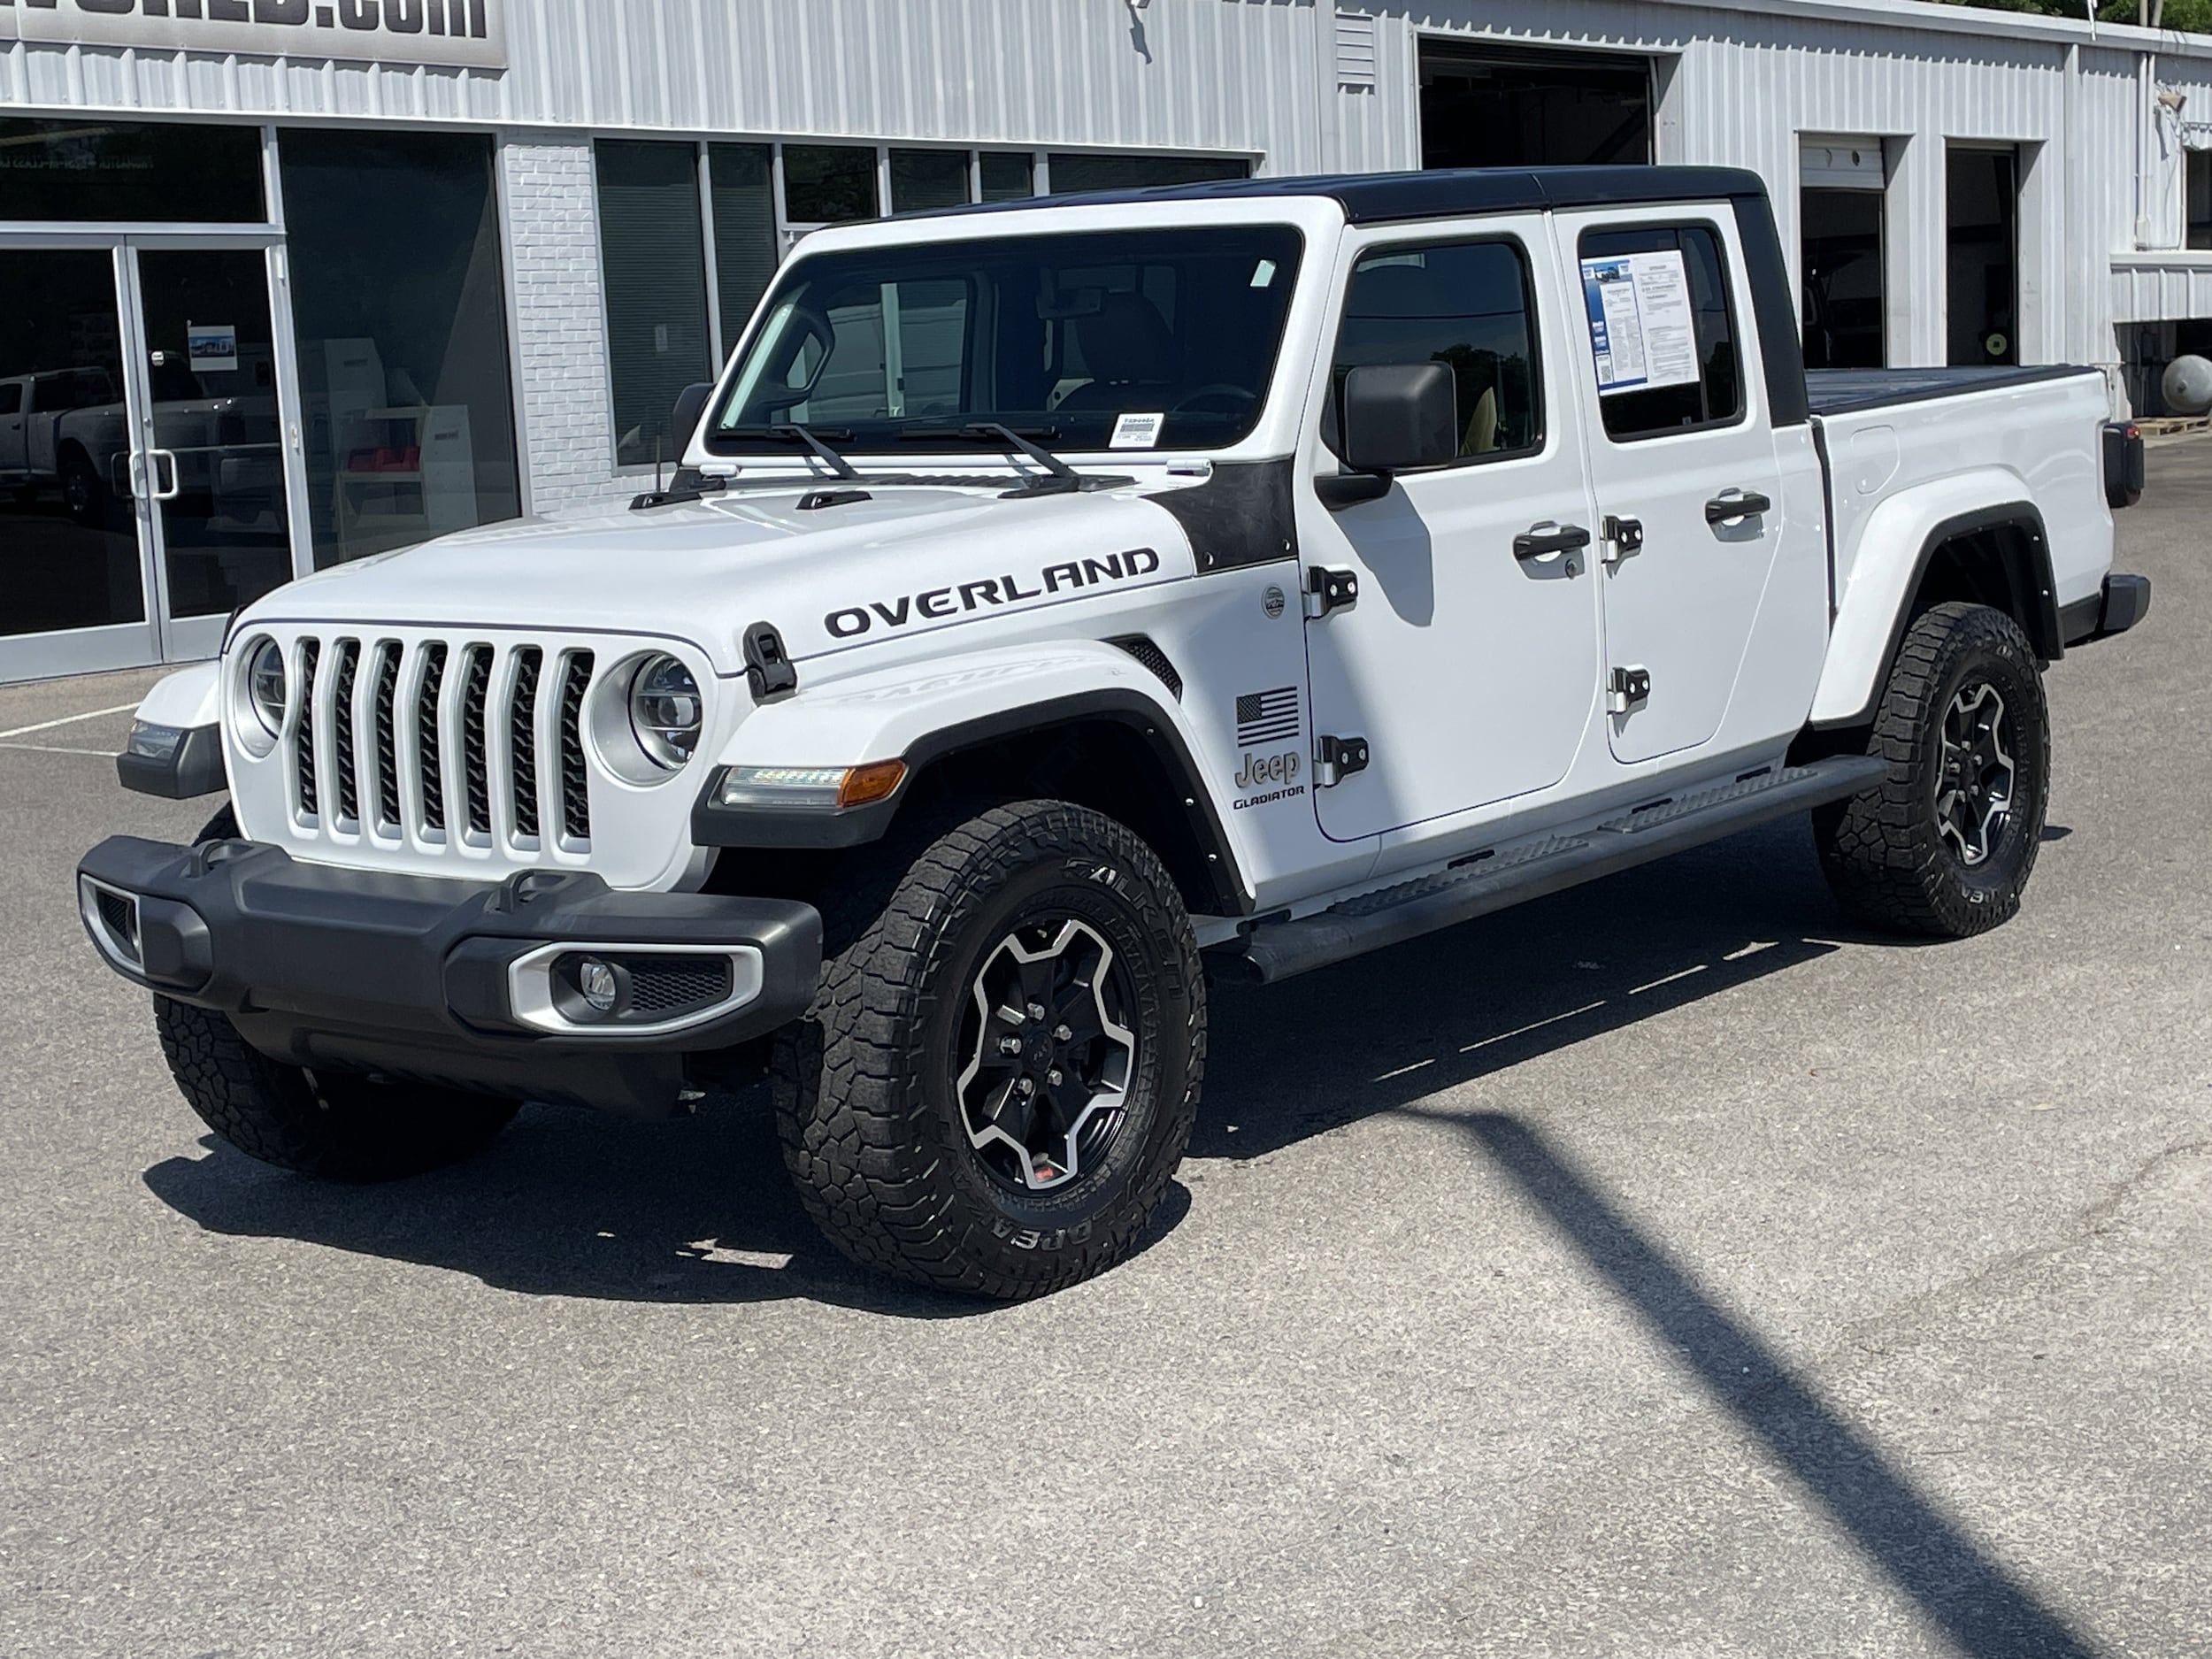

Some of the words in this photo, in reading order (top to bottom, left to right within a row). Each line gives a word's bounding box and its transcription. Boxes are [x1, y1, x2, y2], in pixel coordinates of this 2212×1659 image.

[824, 547, 1159, 638] OVERLAND
[1234, 751, 1301, 788] Jeep
[1233, 785, 1305, 810] GLADIATOR
